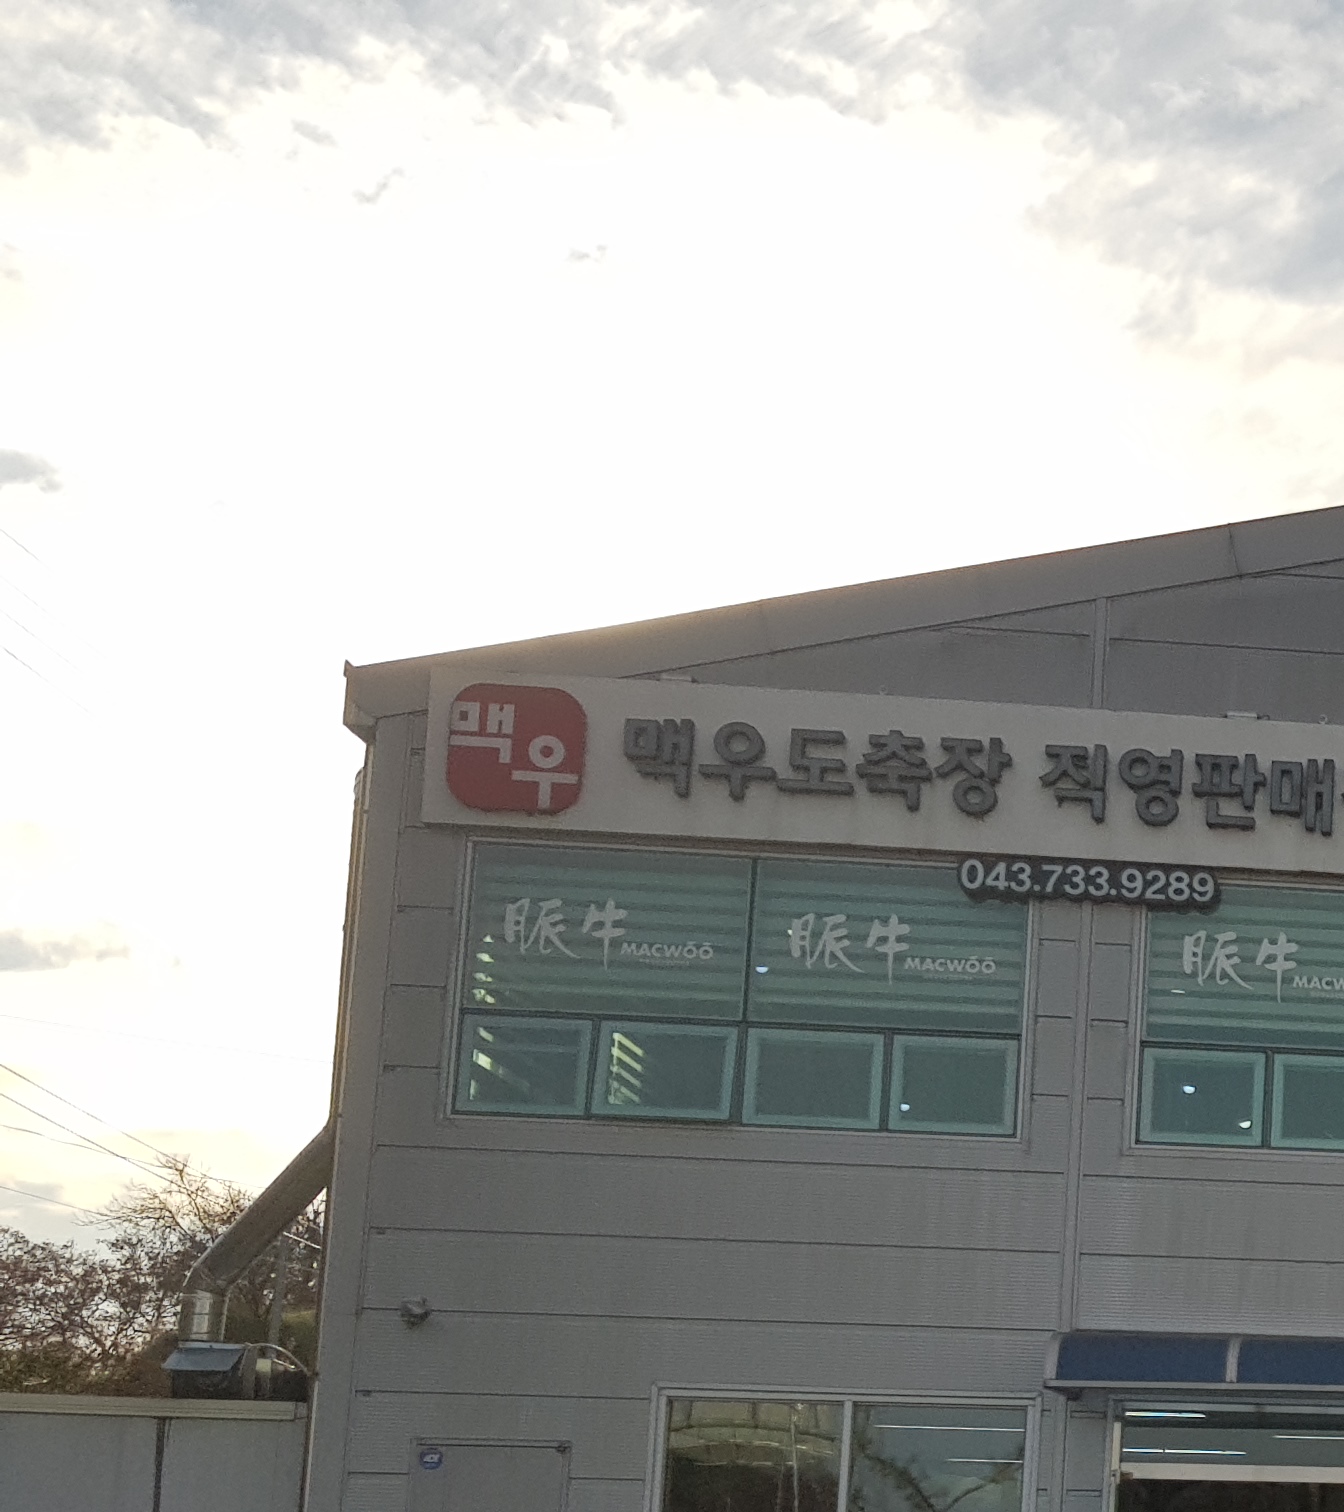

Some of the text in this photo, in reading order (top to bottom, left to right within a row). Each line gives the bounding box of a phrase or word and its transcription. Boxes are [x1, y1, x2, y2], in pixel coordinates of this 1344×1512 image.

[450, 700, 582, 810] 맥우
[623, 717, 1013, 818] 맥우도축장
[959, 858, 1216, 903] 043.733.9289
